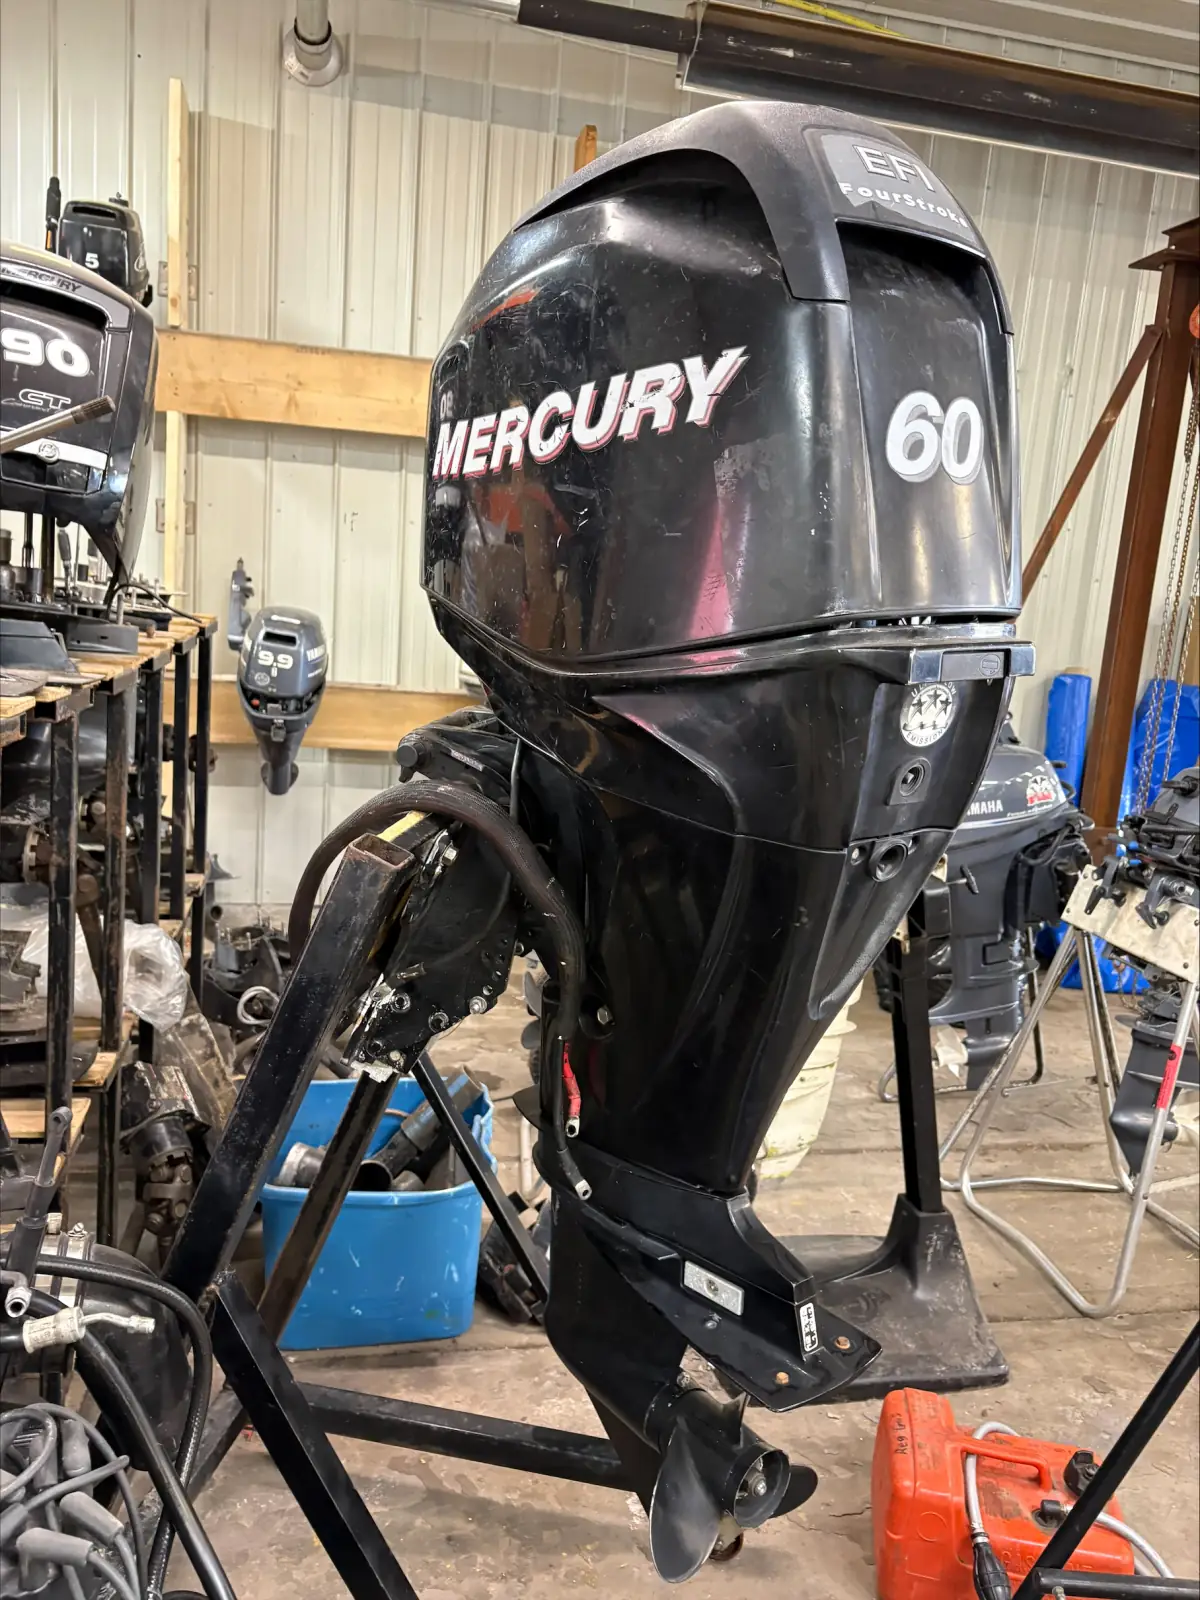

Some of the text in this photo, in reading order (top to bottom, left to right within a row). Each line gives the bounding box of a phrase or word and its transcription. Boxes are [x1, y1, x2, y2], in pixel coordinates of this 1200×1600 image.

[852, 144, 936, 193] EFI
[838, 182, 969, 228] FourStroke
[85, 252, 100, 269] 5
[1, 327, 91, 377] 90
[431, 345, 750, 481] MERCURY
[885, 390, 985, 485] 60
[257, 650, 293, 670] 9.9
[967, 799, 1004, 816] MAHA
